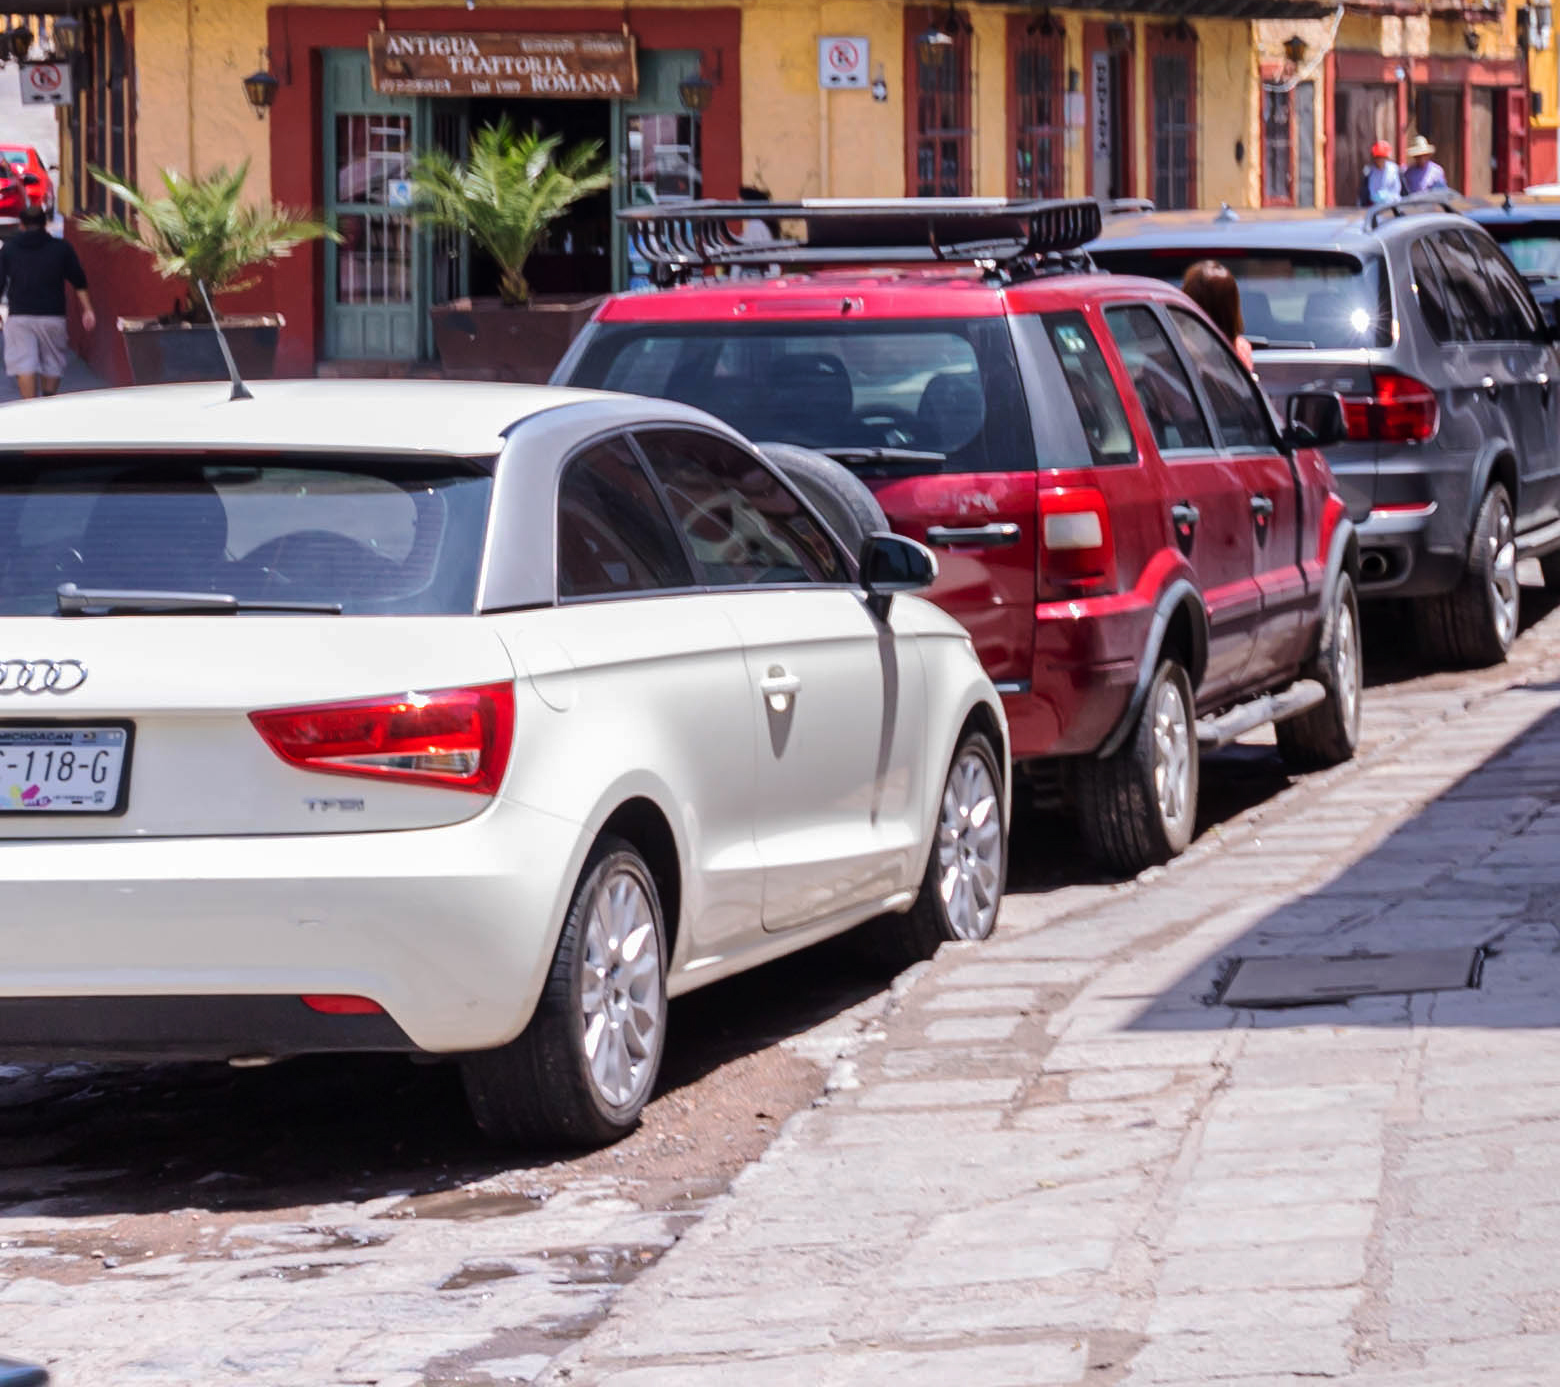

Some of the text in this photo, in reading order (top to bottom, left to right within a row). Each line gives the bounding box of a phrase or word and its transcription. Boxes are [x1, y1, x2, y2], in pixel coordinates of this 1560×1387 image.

[387, 37, 479, 56] ANTIGUA
[448, 56, 567, 75] TRATTORIA
[530, 74, 622, 92] ROMANA
[0, 749, 109, 784] -118-G
